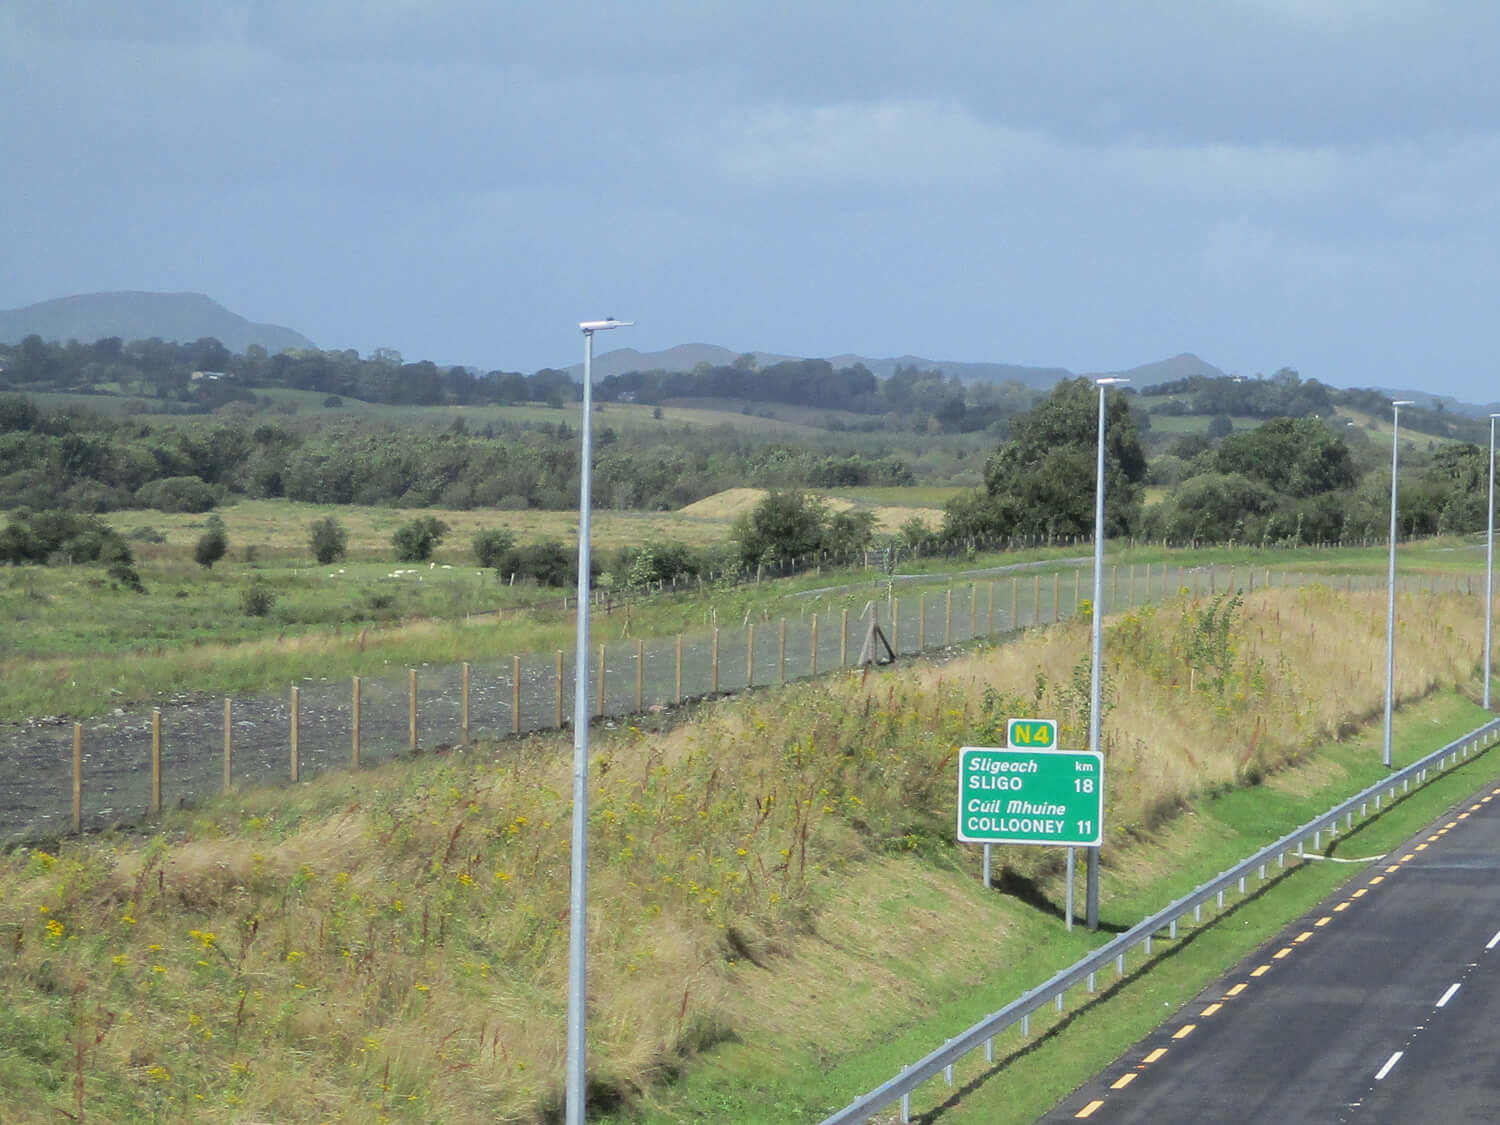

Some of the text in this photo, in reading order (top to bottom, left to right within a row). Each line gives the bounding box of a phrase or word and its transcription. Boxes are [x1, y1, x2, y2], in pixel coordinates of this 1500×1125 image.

[1015, 725, 1049, 744] N4
[968, 757, 1094, 774] Sligeach km
[968, 775, 1094, 793] SLIGO 18
[1006, 799, 1066, 816] Mhuine
[967, 817, 1092, 835] COLLOONEY 11
